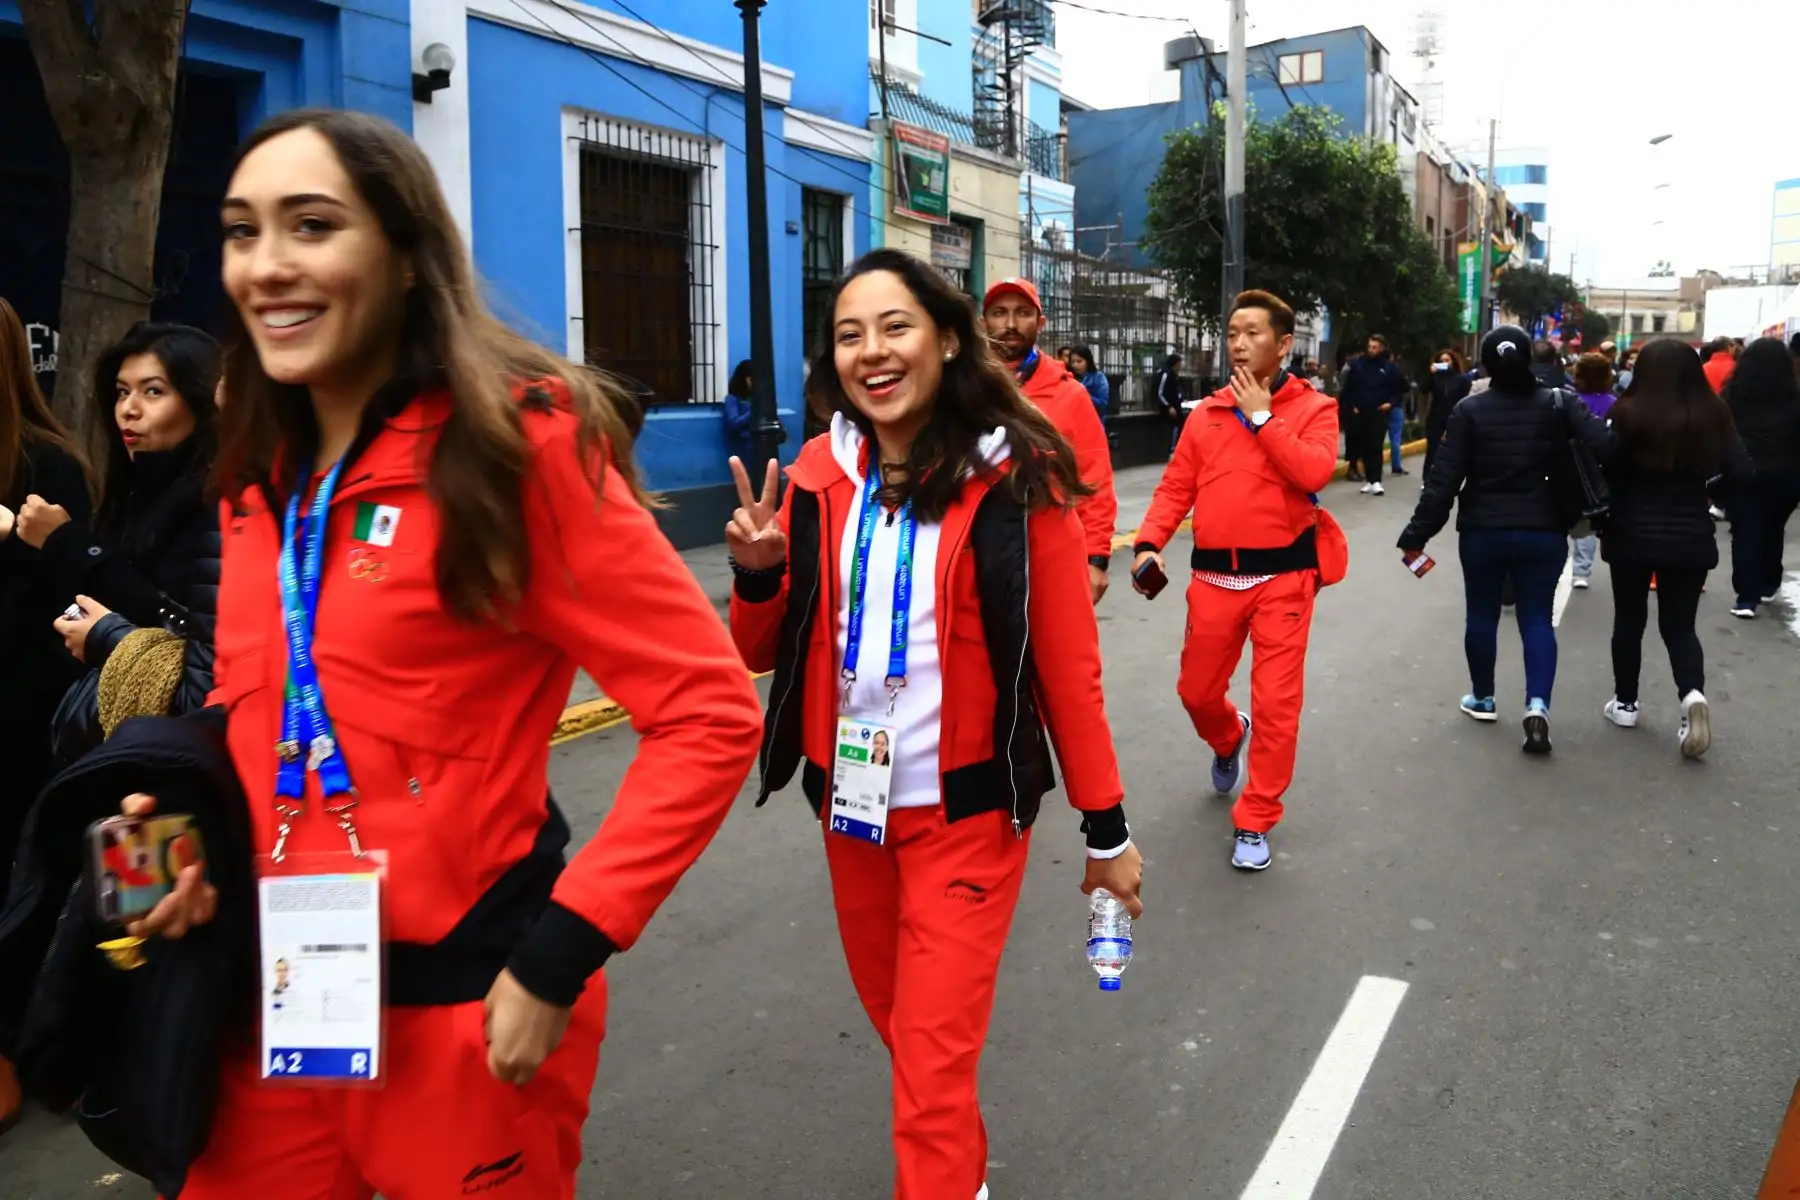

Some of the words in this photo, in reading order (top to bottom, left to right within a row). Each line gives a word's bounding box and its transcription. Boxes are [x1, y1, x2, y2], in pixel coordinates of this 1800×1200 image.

[871, 828, 879, 841] R
[270, 1051, 303, 1074] A2
[350, 1051, 368, 1074] R
